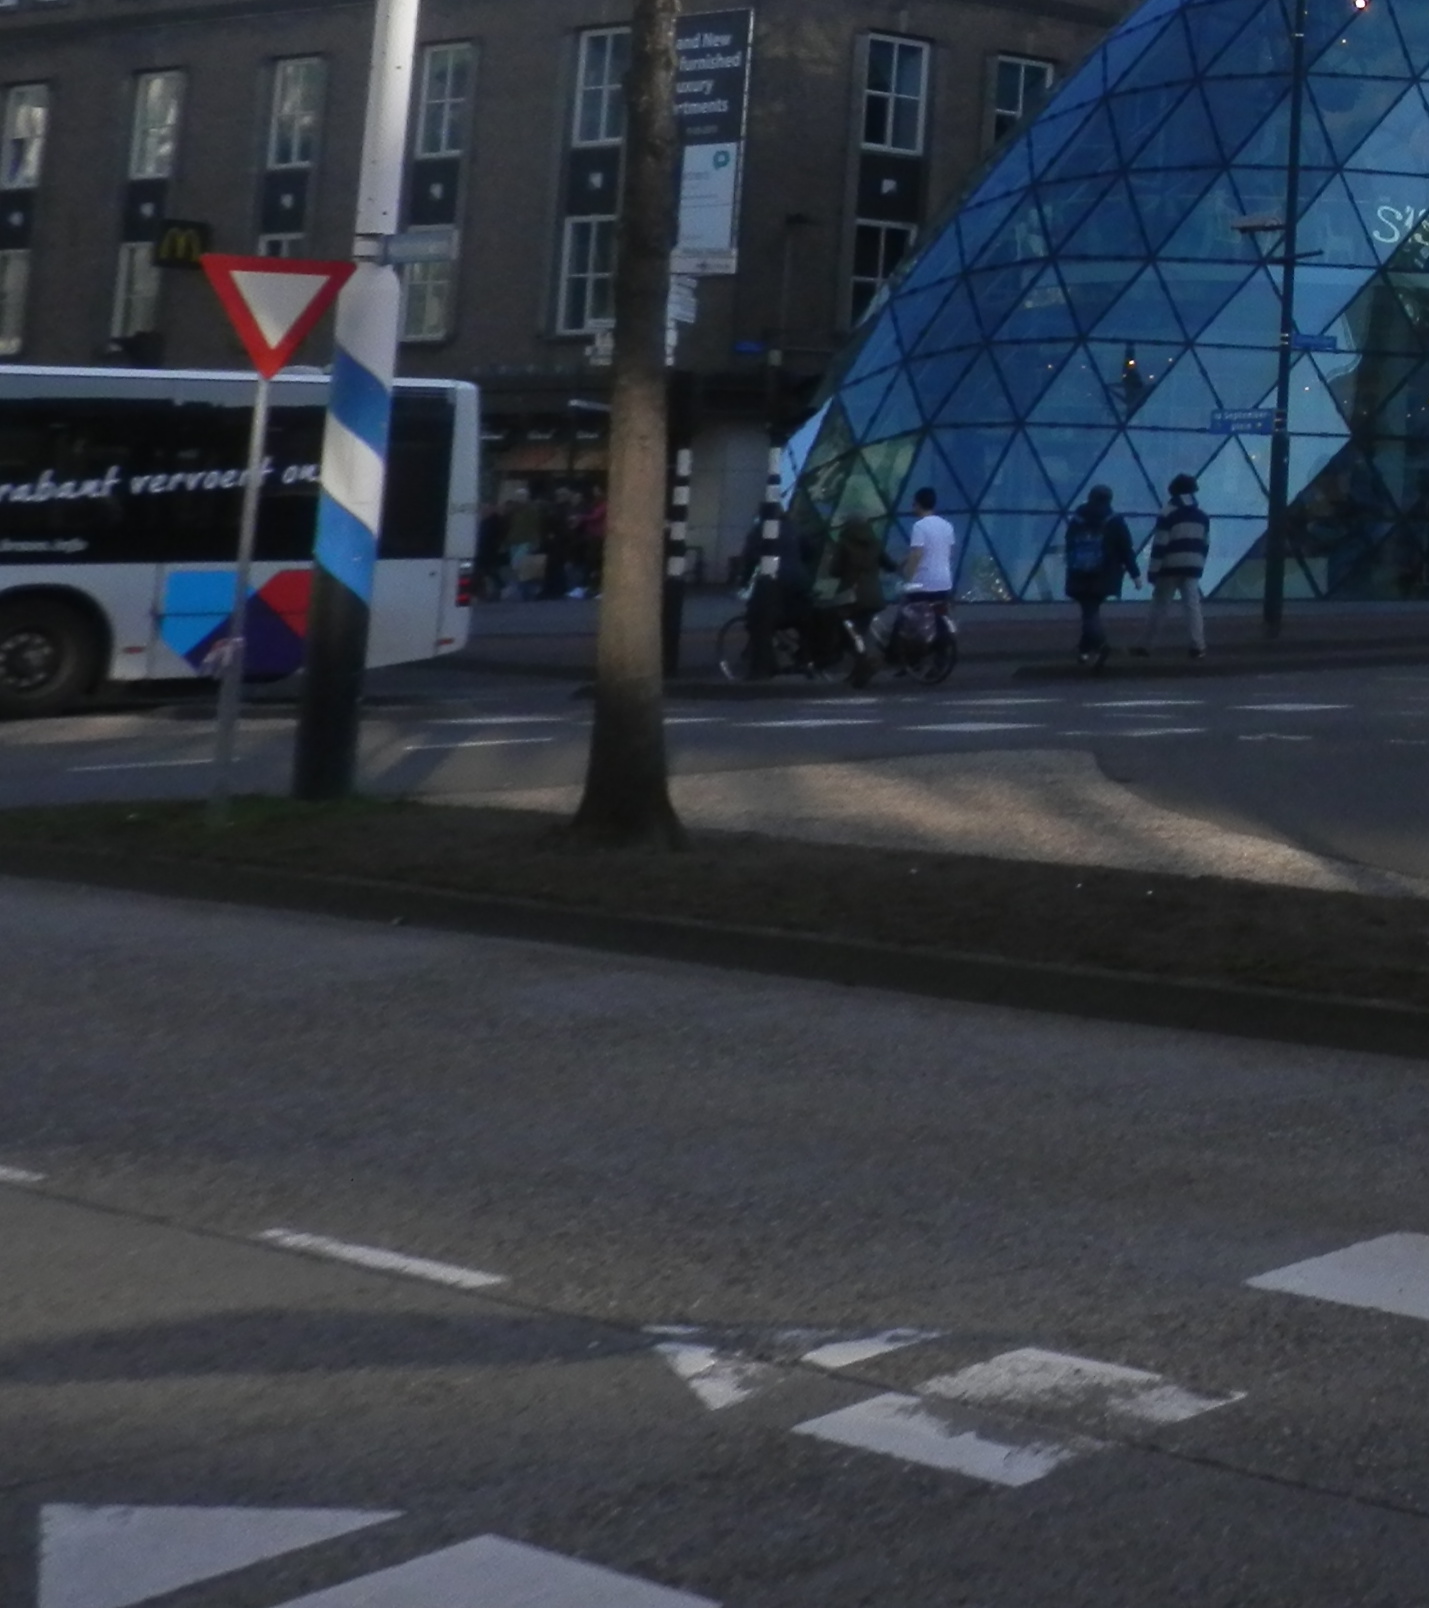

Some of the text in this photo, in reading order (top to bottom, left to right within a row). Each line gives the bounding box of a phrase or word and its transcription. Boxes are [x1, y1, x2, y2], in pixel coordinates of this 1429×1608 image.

[676, 32, 732, 50] and New
[676, 79, 715, 95] uxury
[672, 98, 729, 115] rtments
[0, 464, 120, 502] rabant
[281, 464, 320, 484] on
